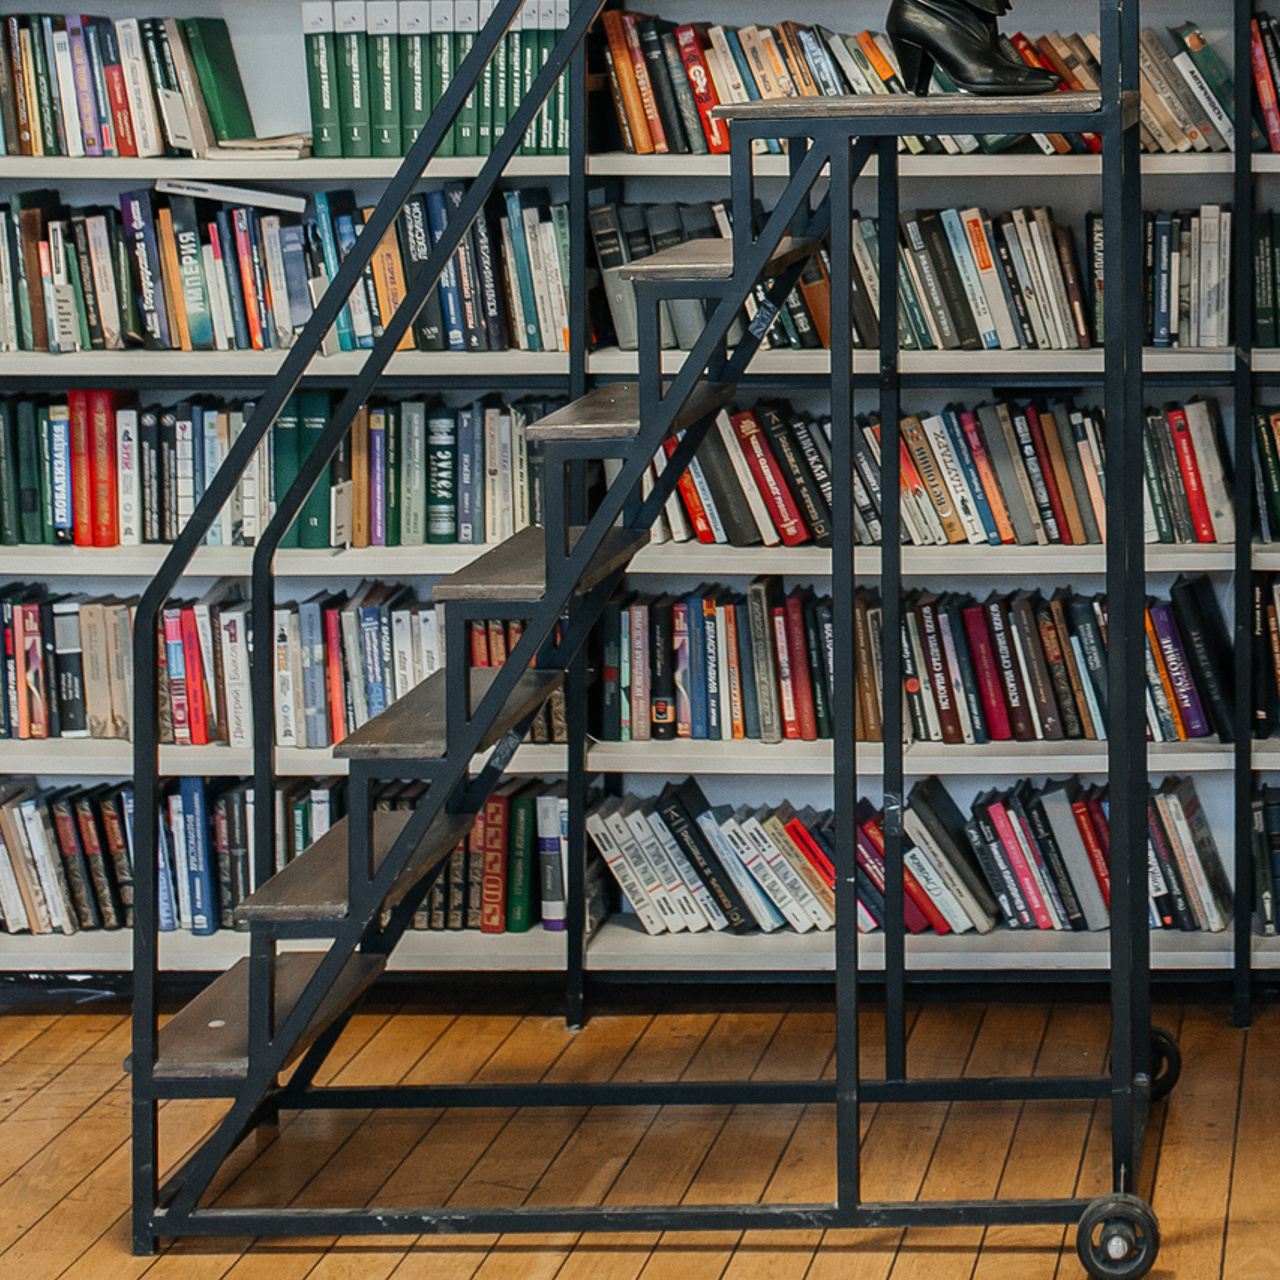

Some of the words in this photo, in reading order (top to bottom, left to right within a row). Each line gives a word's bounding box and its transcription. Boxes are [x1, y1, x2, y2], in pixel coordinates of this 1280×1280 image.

[318, 34, 327, 74] МИГРАЦИЯ
[349, 33, 358, 74] МИГРАЦИЯ
[381, 35, 389, 75] МИГРАЦИЯ
[321, 80, 330, 109] РОССИИ
[352, 80, 360, 108] РОССИИ
[383, 81, 391, 111] РОССИИ
[414, 82, 422, 110] РОССИИ
[1186, 67, 1227, 121] АНТИЧНОСТЬ
[411, 202, 428, 260] ЛЕКСИКОН
[175, 230, 207, 315] ИМПЕРИЯ
[383, 252, 397, 285] ИСТОРИЯ
[461, 453, 470, 483] НЕРОН
[778, 434, 801, 476] ХРИСТОС
[792, 419, 826, 482] РИМСКАЯ
[931, 428, 966, 495] ПЛУТАРХ
[53, 424, 68, 523] ГЛОБАЛИЗАЦИЯ
[920, 605, 935, 633] ВЕКОВ
[989, 603, 1005, 632] ВЕКОВ
[228, 645, 239, 681] Быков
[704, 620, 718, 693] ДЕМОГРАФИЯ
[925, 634, 941, 671] СРЕДНИХ
[995, 632, 1012, 669] СРЕДНИХ
[932, 671, 949, 710] ИСТОРИЯ
[1003, 669, 1020, 707] ИСТОРИЯ
[1158, 634, 1192, 708] КРЕСТОВЫЕ
[232, 688, 245, 739] Дмитрий
